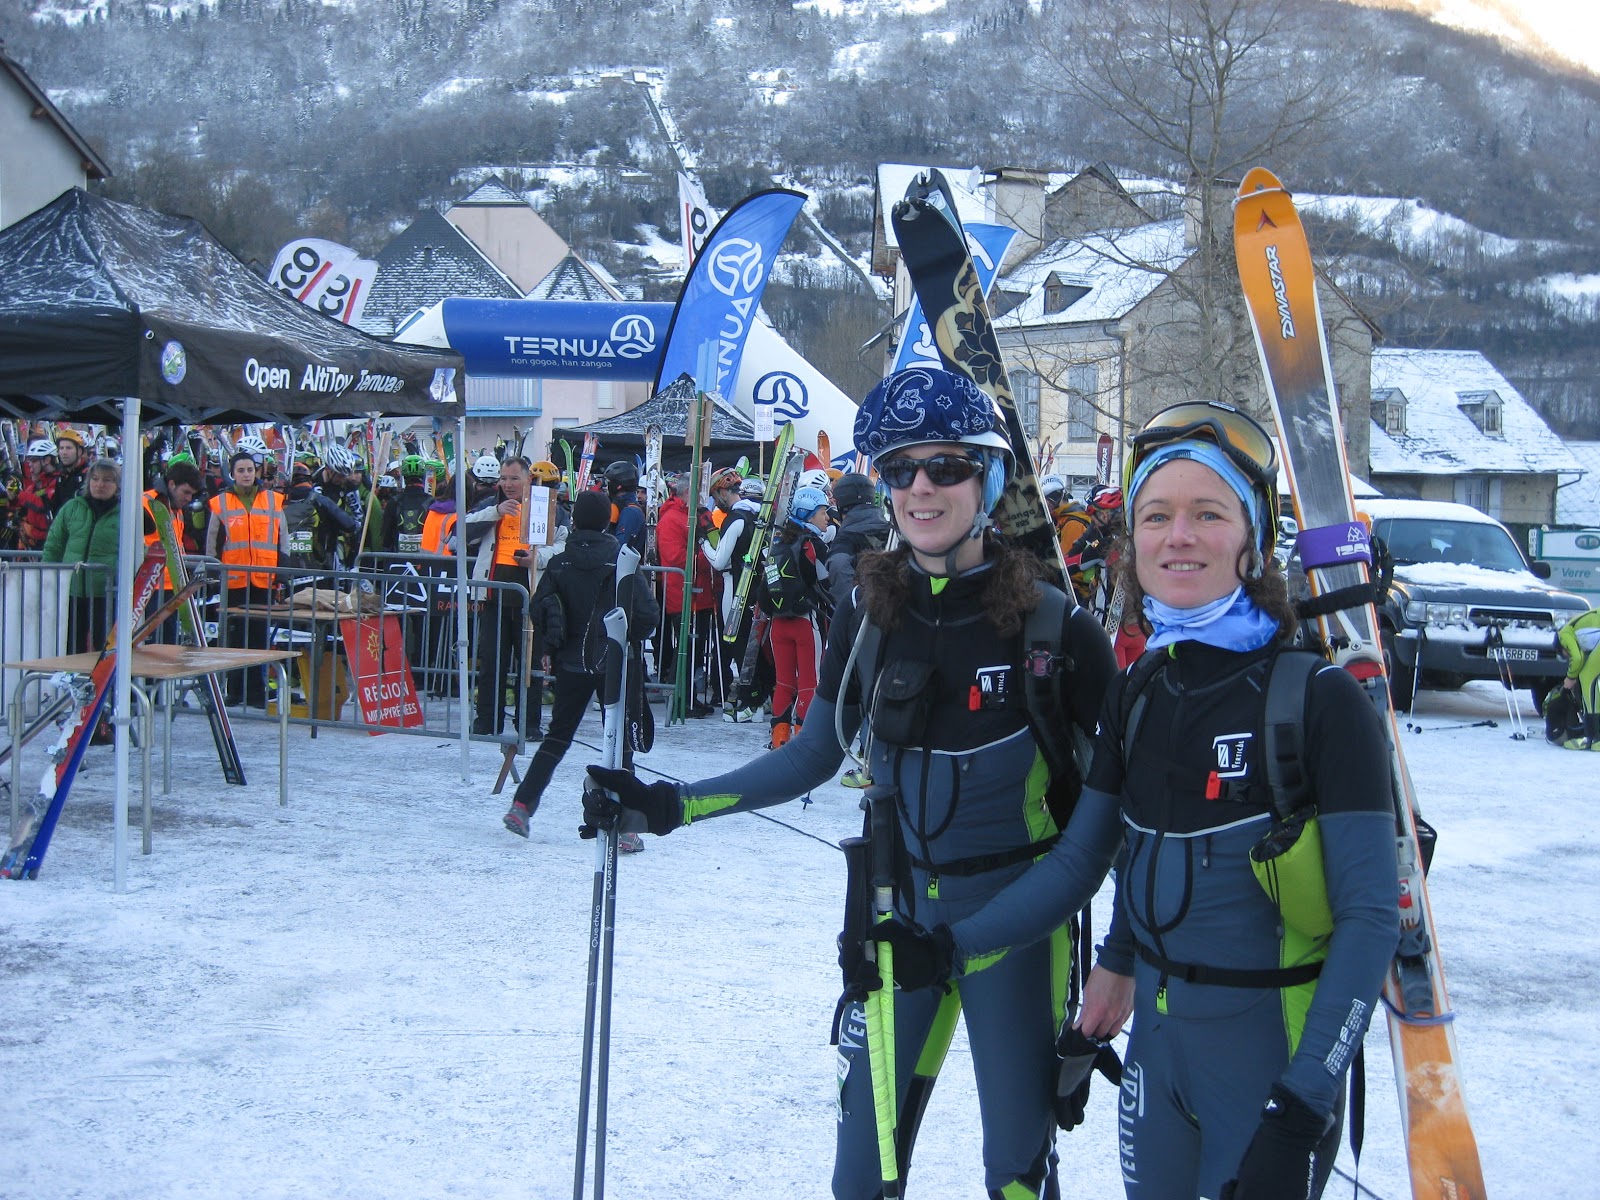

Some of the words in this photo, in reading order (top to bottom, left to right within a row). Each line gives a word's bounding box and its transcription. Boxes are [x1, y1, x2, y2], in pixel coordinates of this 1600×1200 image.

[1265, 245, 1296, 339] DYNASTAR
[504, 336, 616, 358] TERNUA
[529, 359, 560, 367] gogoa,
[561, 358, 579, 367] han
[580, 361, 612, 369] zangoa
[245, 358, 291, 393] Open
[300, 364, 354, 397] AltiToy
[797, 493, 821, 506] GRIVEL
[1561, 567, 1590, 578] Verre
[1524, 650, 1537, 660] 65
[364, 682, 410, 703] RÉGION
[1231, 740, 1245, 769] VERTICAL
[606, 846, 614, 891] Quechua
[591, 905, 601, 949] Quechua
[1119, 1061, 1144, 1184] VERTICAL
